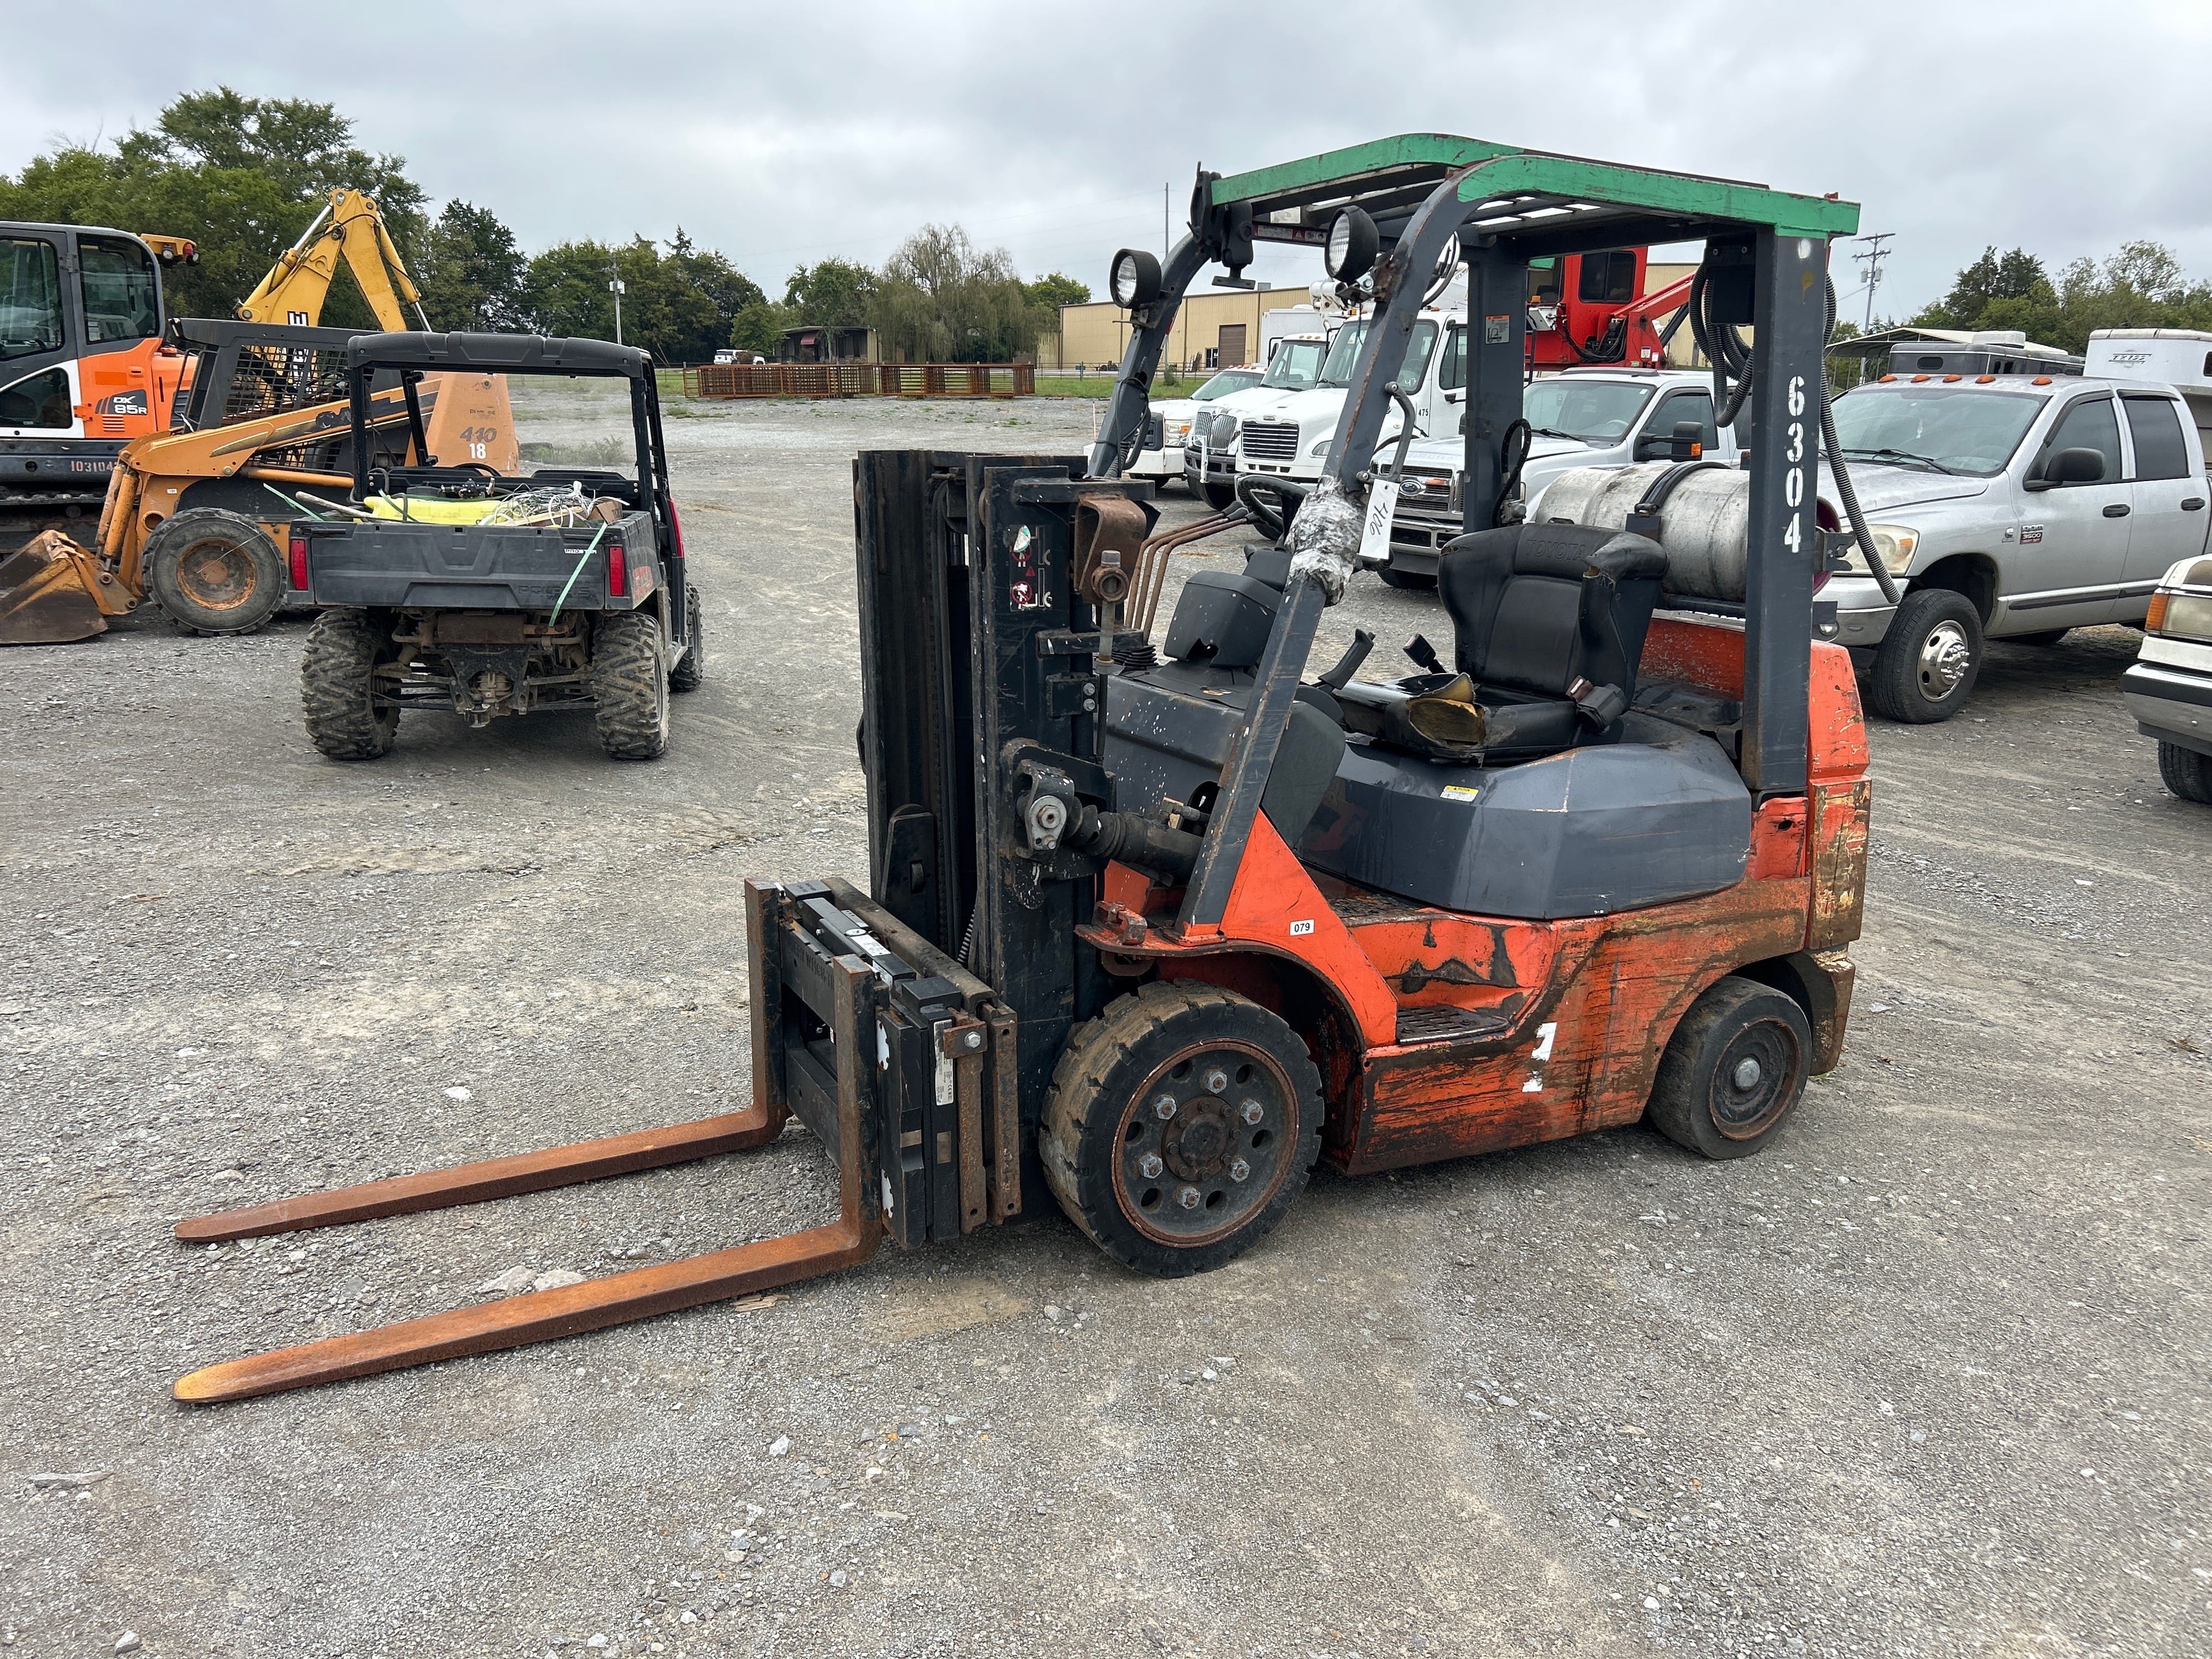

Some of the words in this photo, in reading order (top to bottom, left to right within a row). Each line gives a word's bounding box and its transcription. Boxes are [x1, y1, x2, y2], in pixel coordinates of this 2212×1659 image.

[1405, 378, 1416, 386] 43
[113, 395, 136, 404] DX
[114, 404, 148, 414] 85R
[1418, 408, 1429, 416] 475
[460, 426, 497, 443] 410
[469, 442, 487, 459] 18
[70, 460, 117, 472] 103104
[1784, 375, 1805, 554] 6304
[1369, 502, 1389, 535] 406
[1525, 539, 1586, 562] TOYOTA
[1294, 922, 1310, 932] 079
